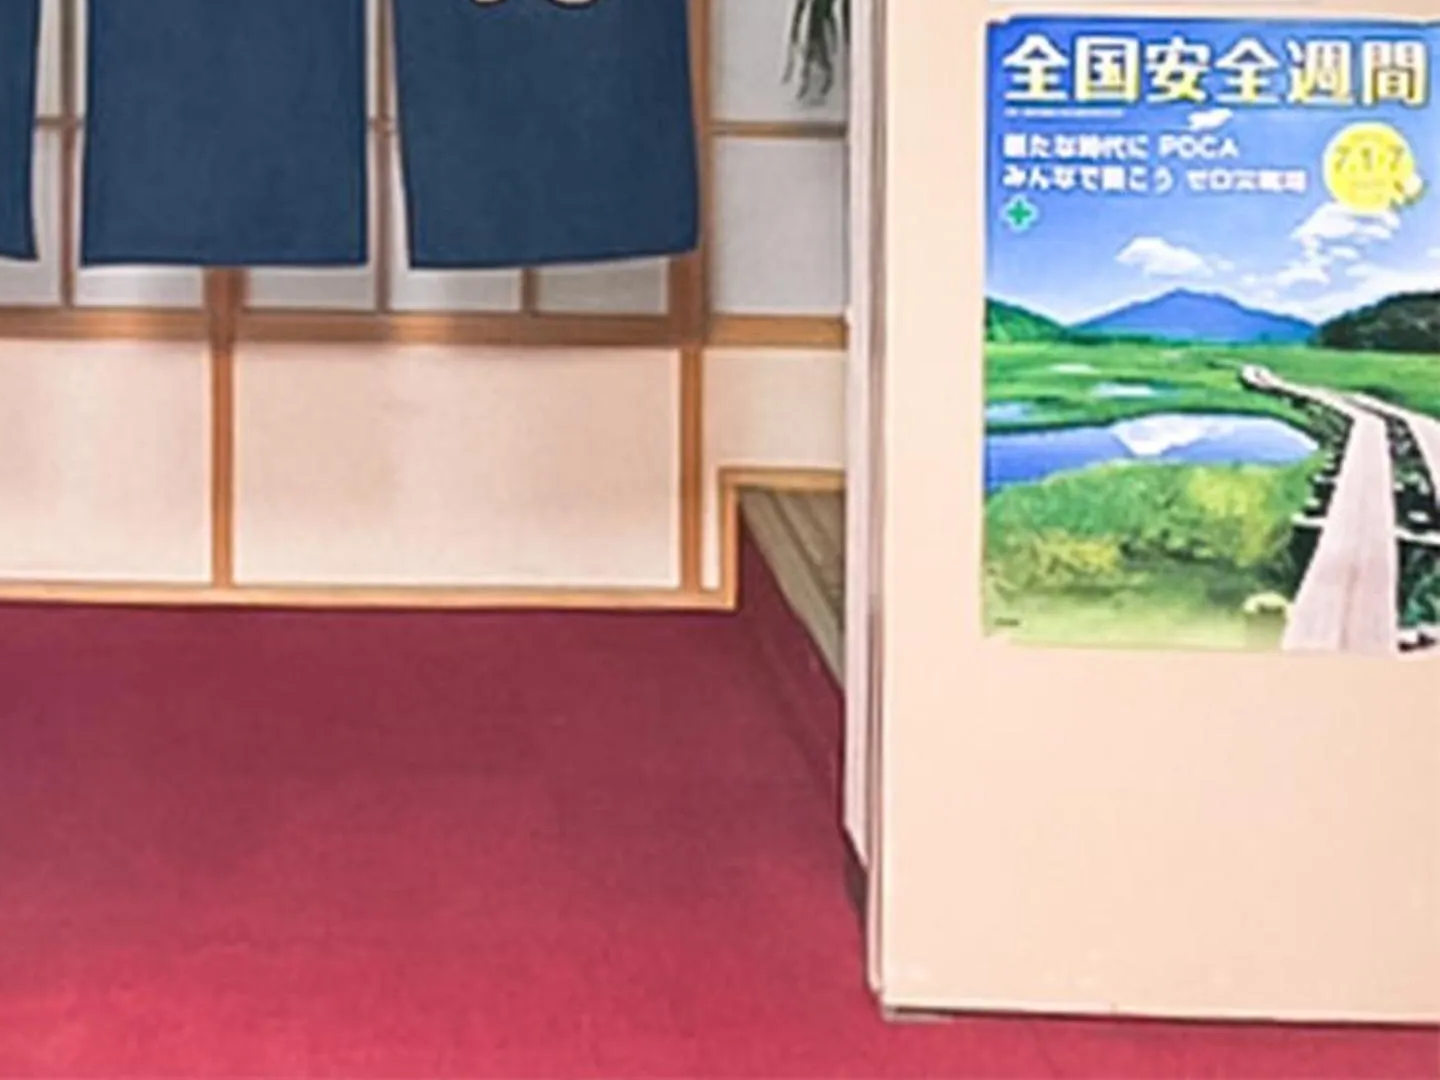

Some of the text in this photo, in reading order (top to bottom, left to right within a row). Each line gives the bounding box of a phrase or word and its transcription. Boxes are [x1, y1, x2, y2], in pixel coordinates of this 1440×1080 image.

[1002, 33, 1428, 106] 全国安全週間
